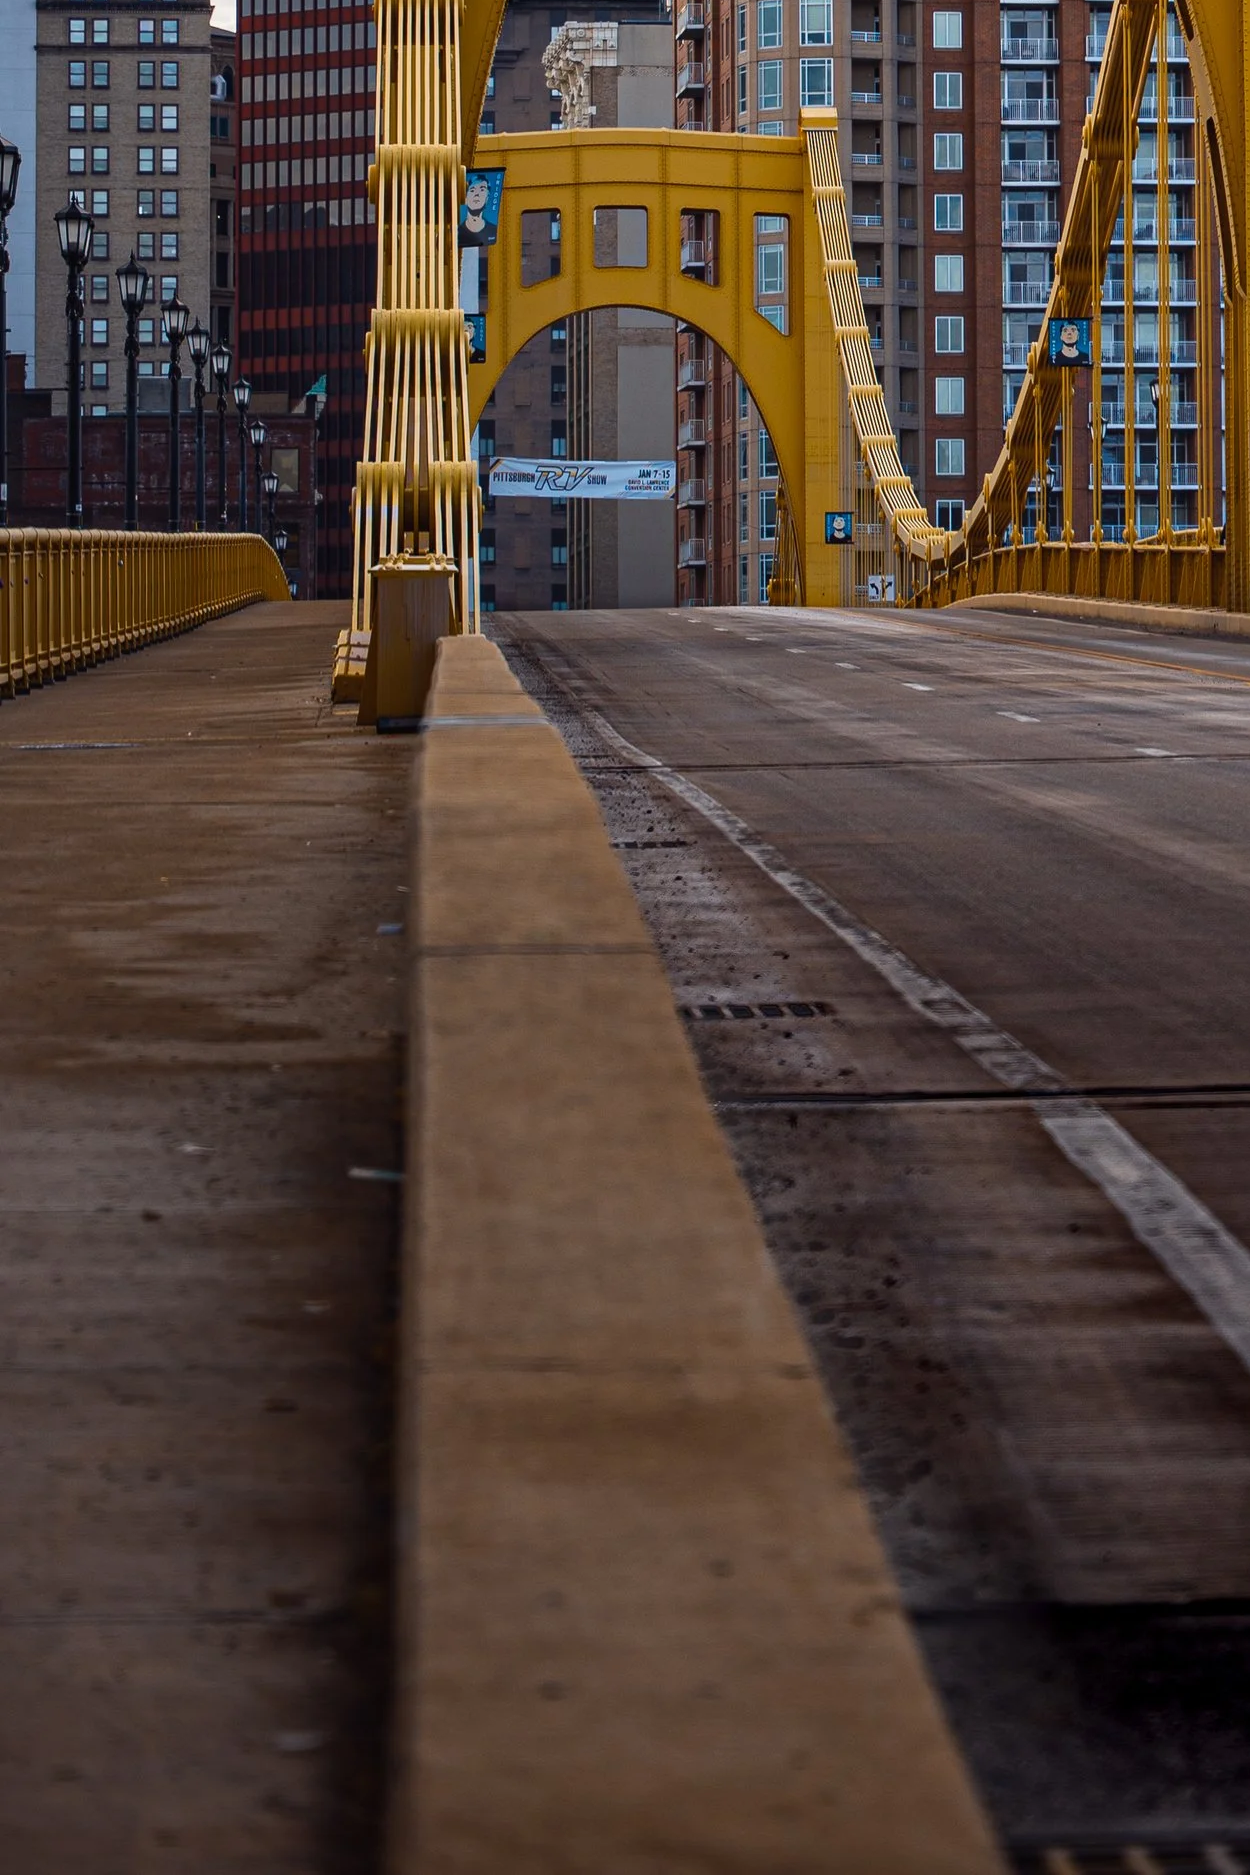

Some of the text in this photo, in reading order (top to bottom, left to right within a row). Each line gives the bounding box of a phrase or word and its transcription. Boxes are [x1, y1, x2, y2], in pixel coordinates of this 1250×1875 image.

[493, 465, 607, 491] PITTSBURGH RV SHOW
[638, 469, 652, 479] JAN
